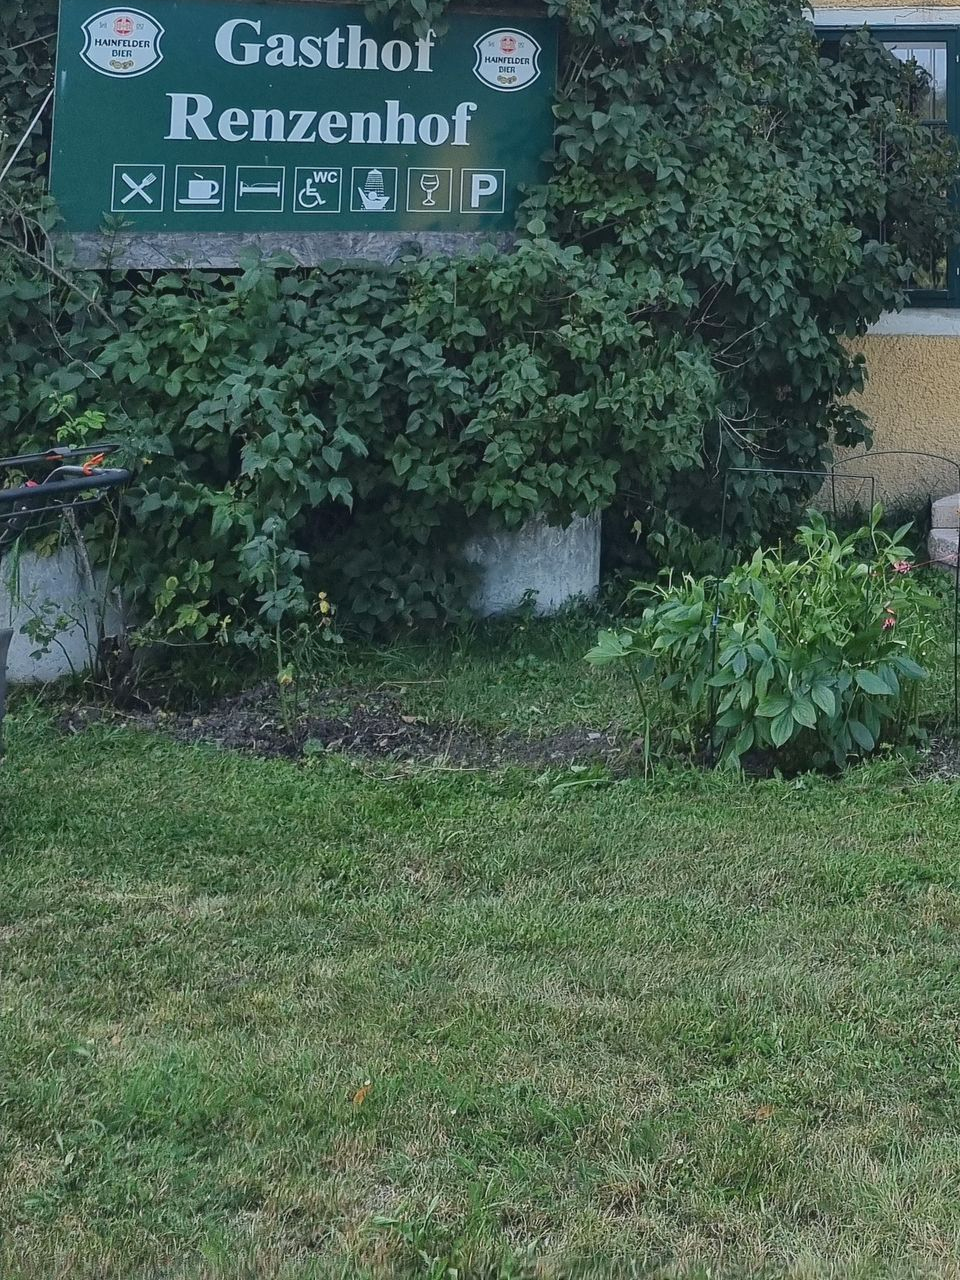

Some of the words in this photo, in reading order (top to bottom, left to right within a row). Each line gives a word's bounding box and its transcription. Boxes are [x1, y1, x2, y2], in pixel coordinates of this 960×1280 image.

[94, 38, 151, 48] HAINFELDER
[214, 18, 437, 72] Gasthof
[111, 49, 133, 58] BIER
[484, 55, 531, 65] HAINFELDER
[498, 65, 516, 74] BIER
[163, 92, 478, 146] Renzenhof
[312, 170, 338, 184] WC
[471, 173, 498, 208] P
